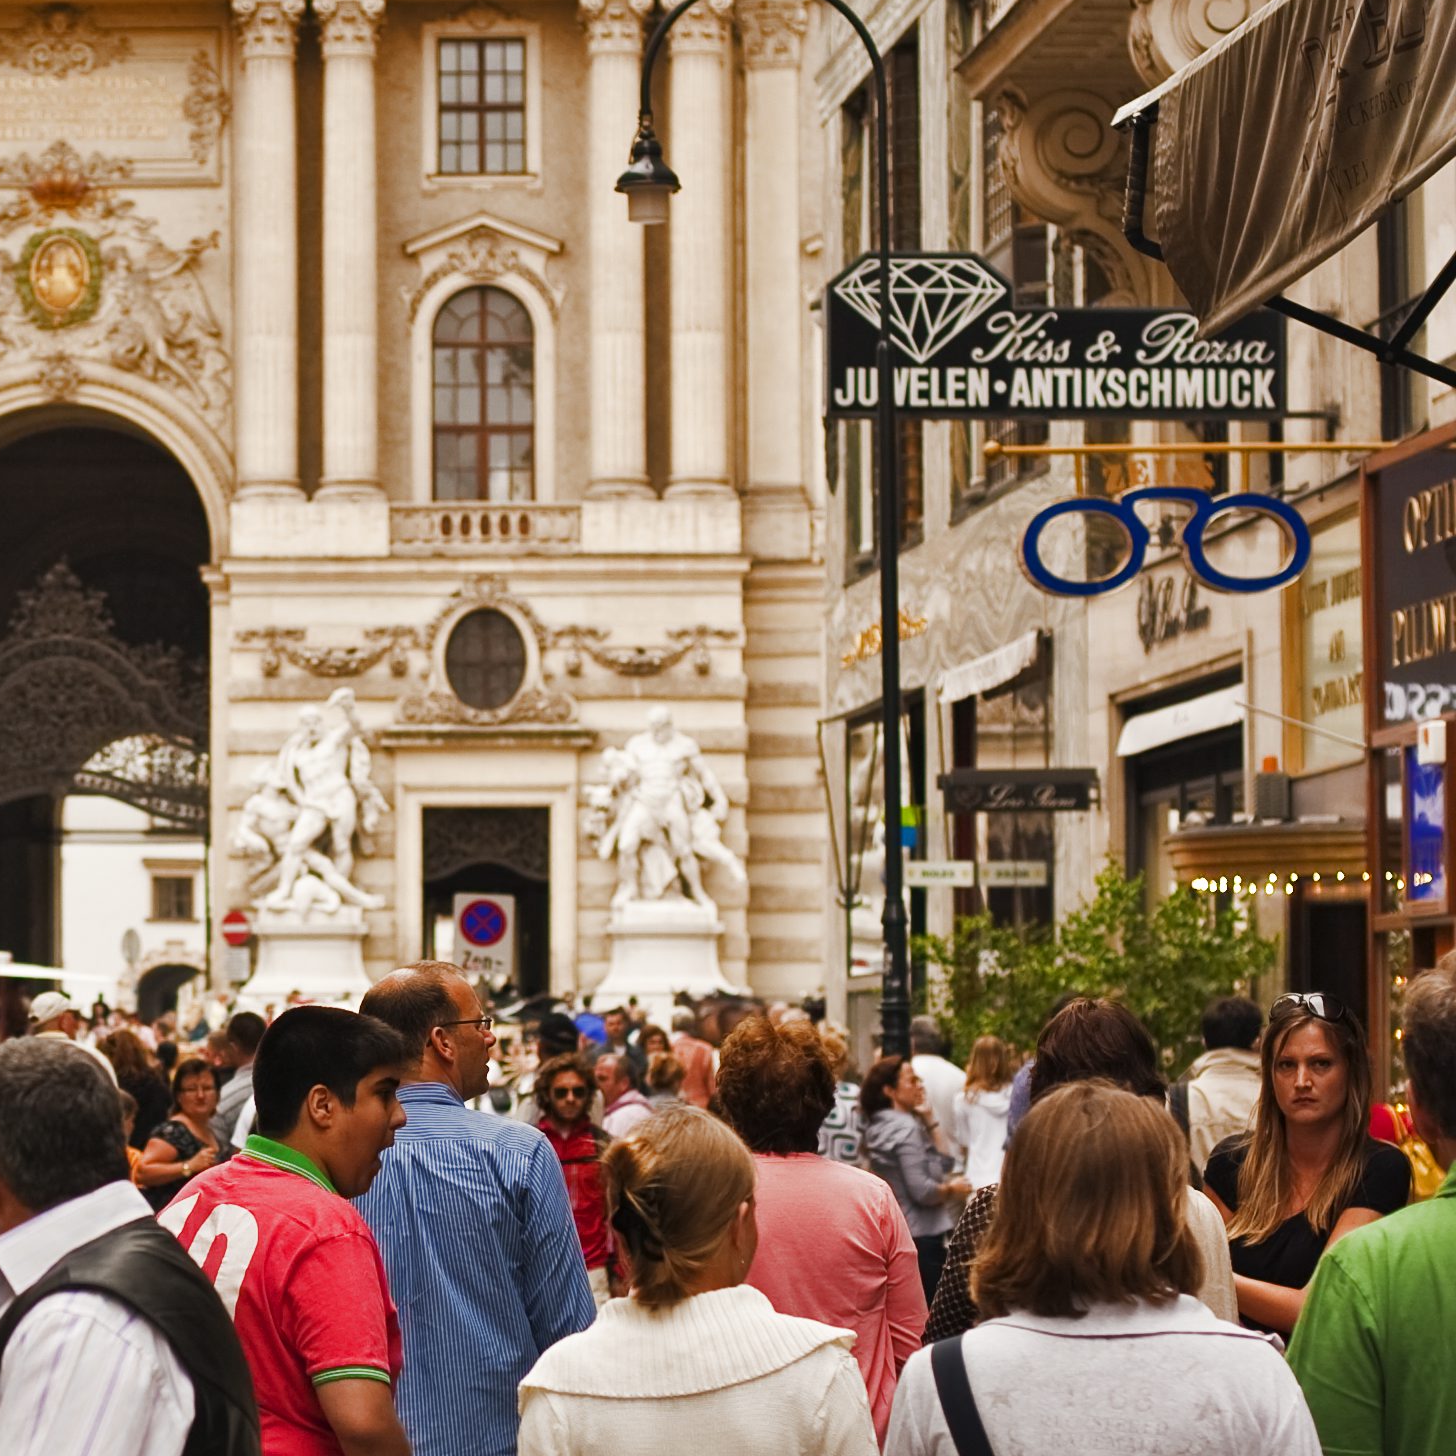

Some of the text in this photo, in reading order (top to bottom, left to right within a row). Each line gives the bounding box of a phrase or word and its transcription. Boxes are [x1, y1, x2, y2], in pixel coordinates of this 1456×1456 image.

[971, 310, 1072, 364] Kiss
[1085, 330, 1122, 363] &
[1010, 367, 1276, 408] ANTIKSCHMUCK
